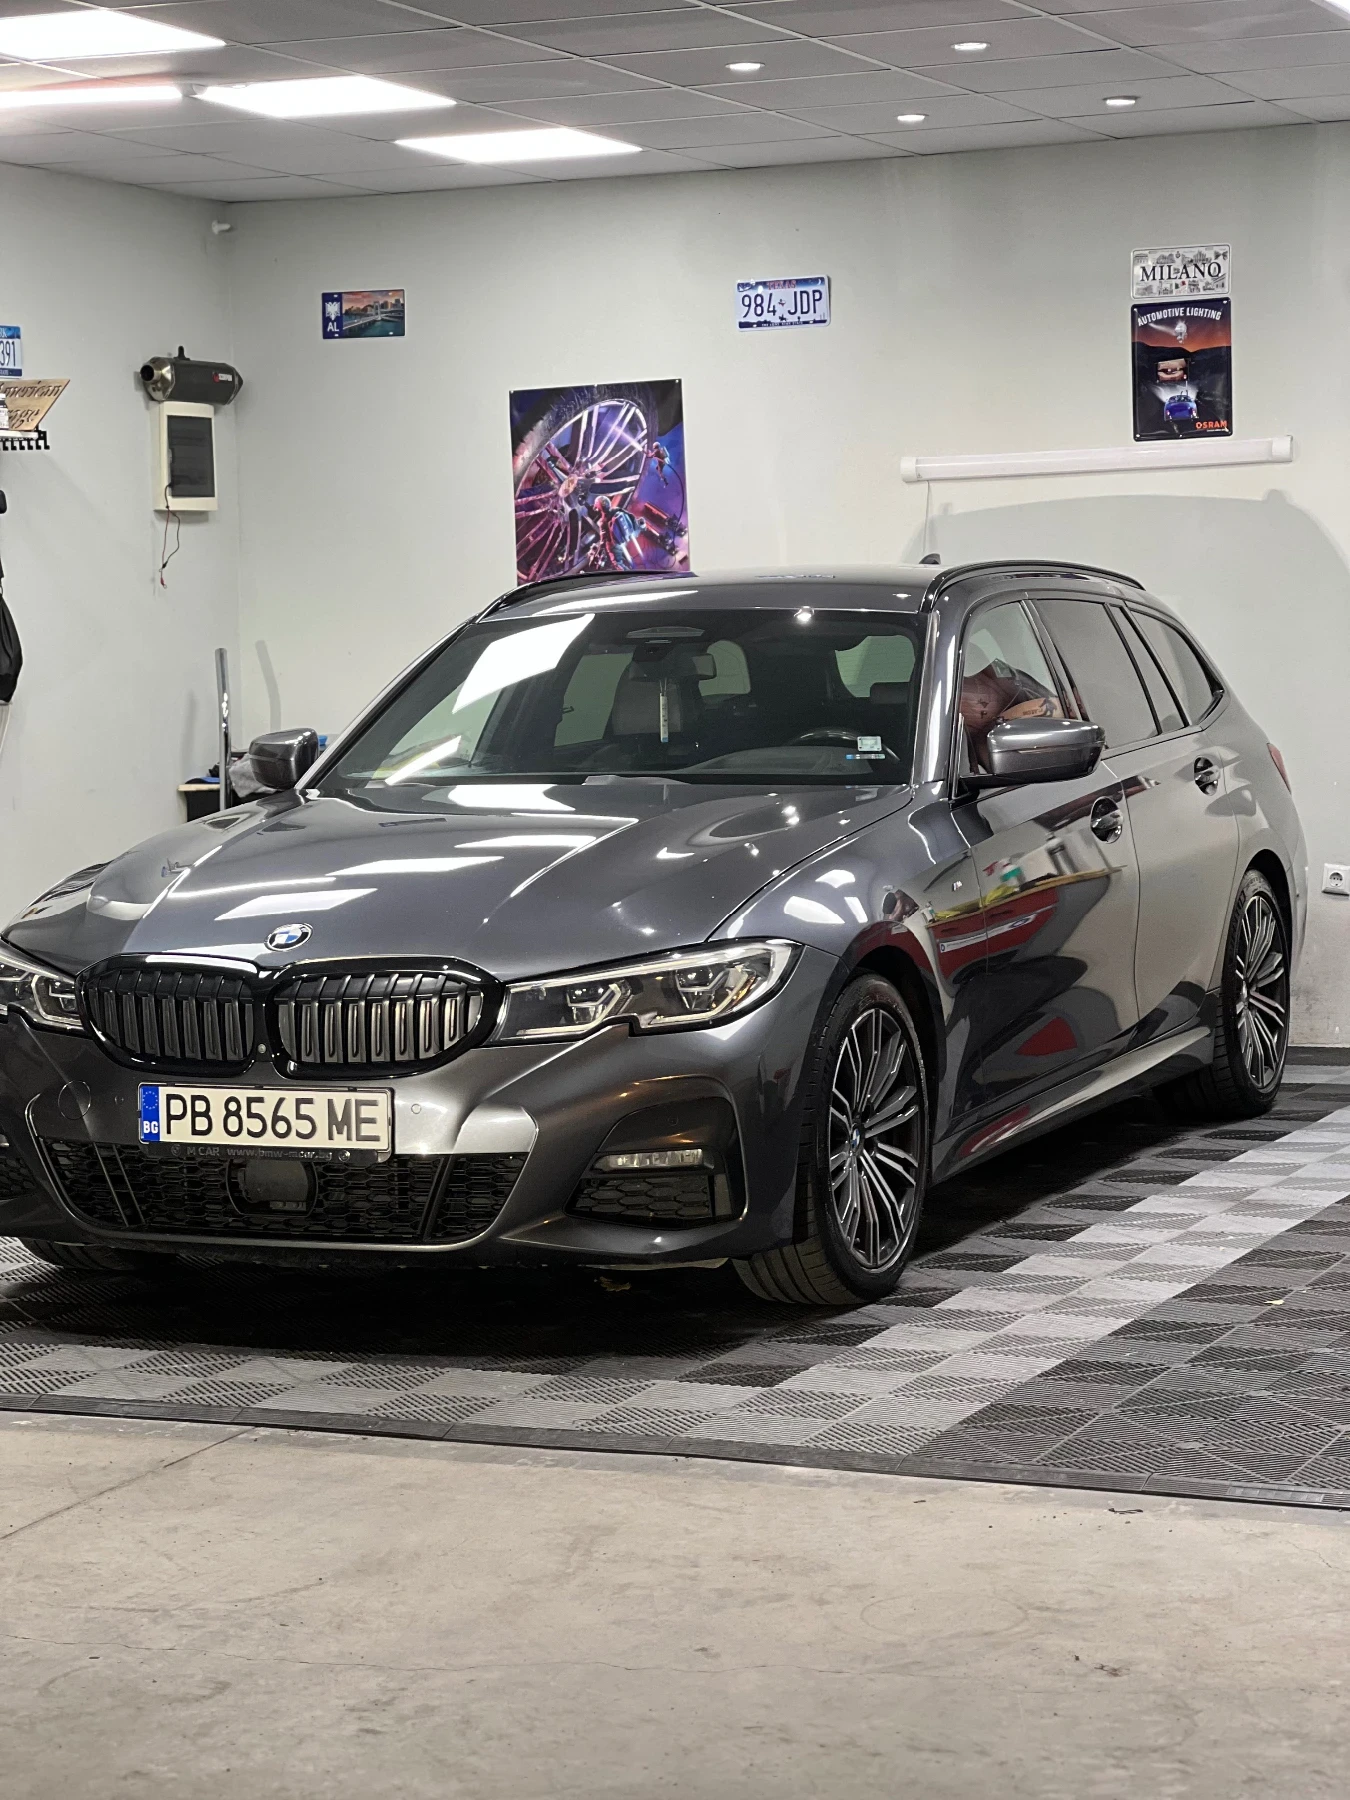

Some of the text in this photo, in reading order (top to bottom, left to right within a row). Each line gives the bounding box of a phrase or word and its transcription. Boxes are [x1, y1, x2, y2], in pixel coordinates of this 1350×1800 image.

[1140, 262, 1222, 282] MILANO
[767, 280, 797, 290] TEXAS
[741, 289, 823, 318] 984 JDP
[1138, 307, 1222, 327] AUTOMOTIVE LIGHTING
[327, 322, 340, 332] AL
[1196, 420, 1228, 429] OSRAM
[165, 1093, 381, 1142] PB 8565 ME
[143, 1120, 159, 1134] BG
[200, 1147, 220, 1156] CAR
